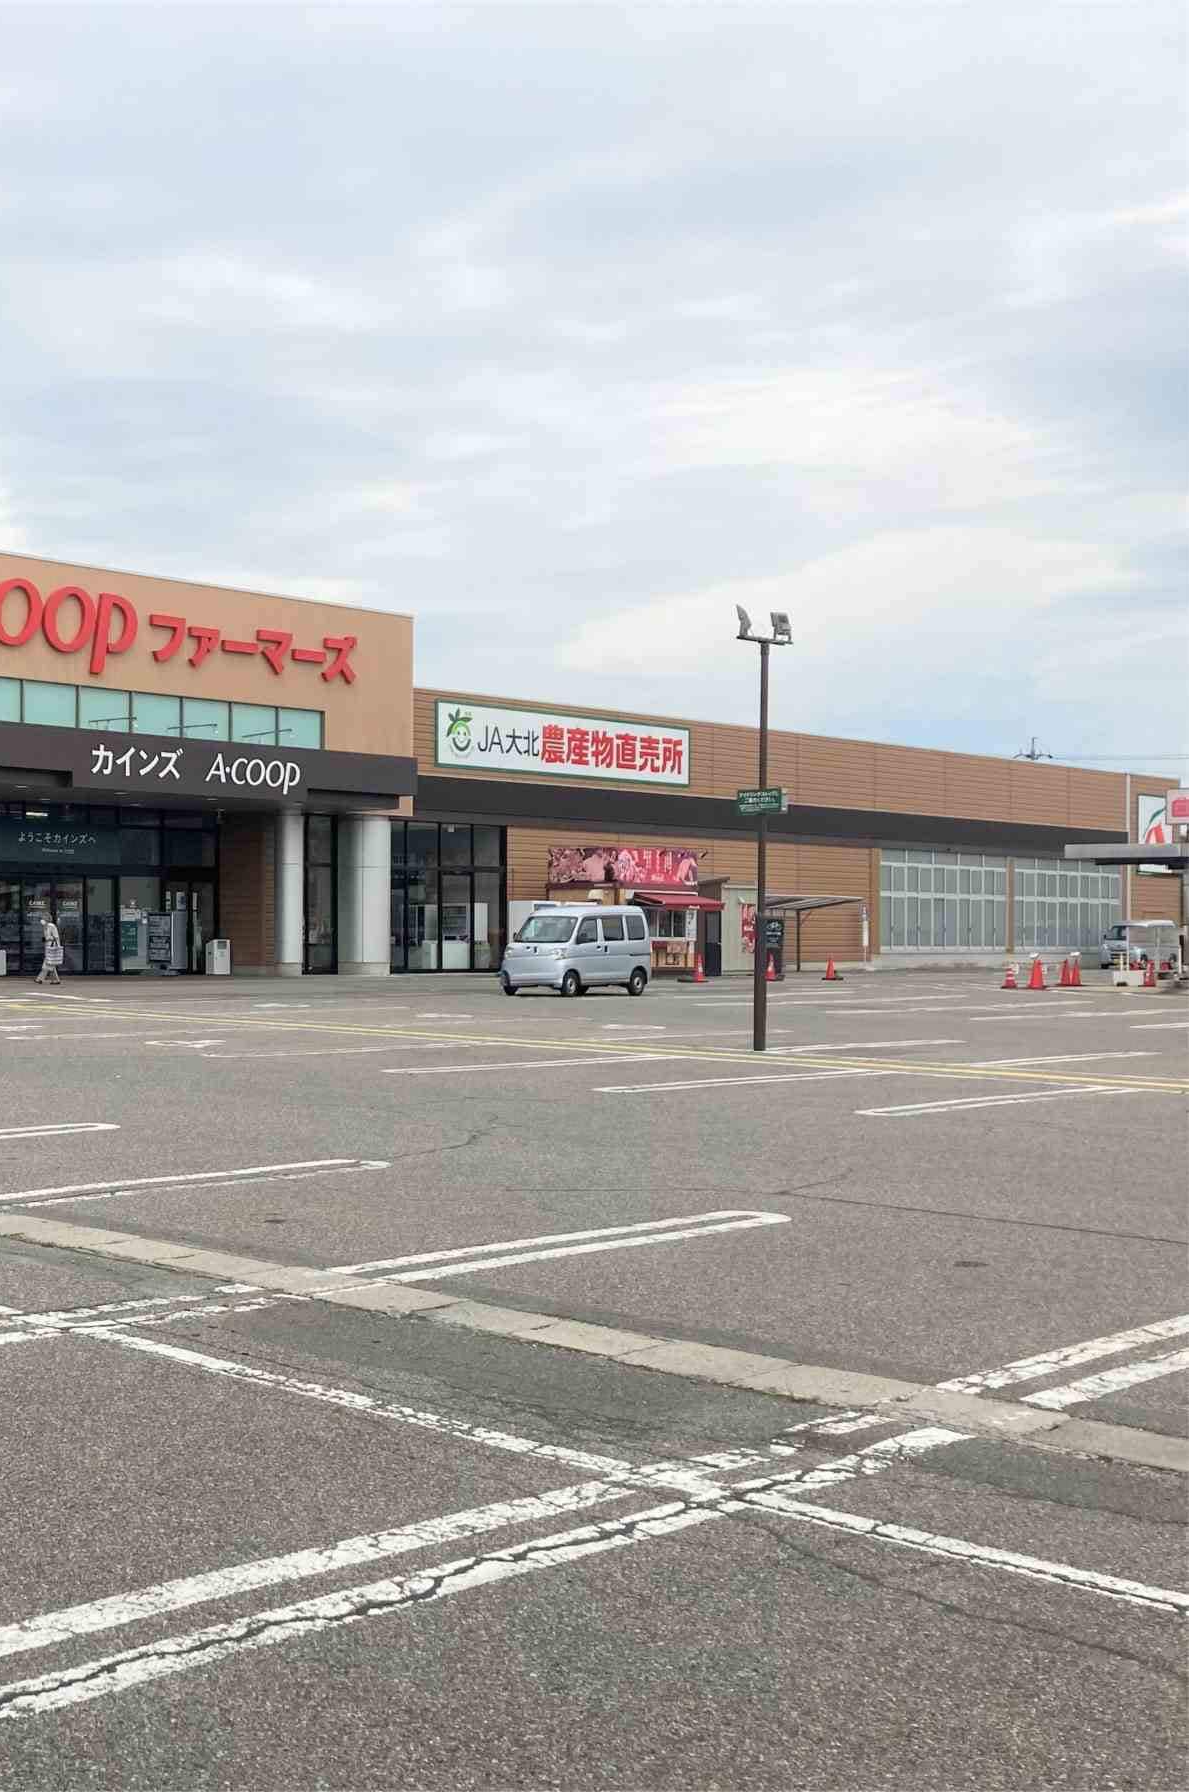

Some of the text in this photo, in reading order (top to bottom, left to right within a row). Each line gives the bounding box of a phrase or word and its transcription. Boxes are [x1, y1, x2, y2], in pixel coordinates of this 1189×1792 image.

[148, 612, 358, 685] ファーマーズ
[91, 744, 184, 780] カインズ
[541, 724, 683, 775] 農産物直売所
